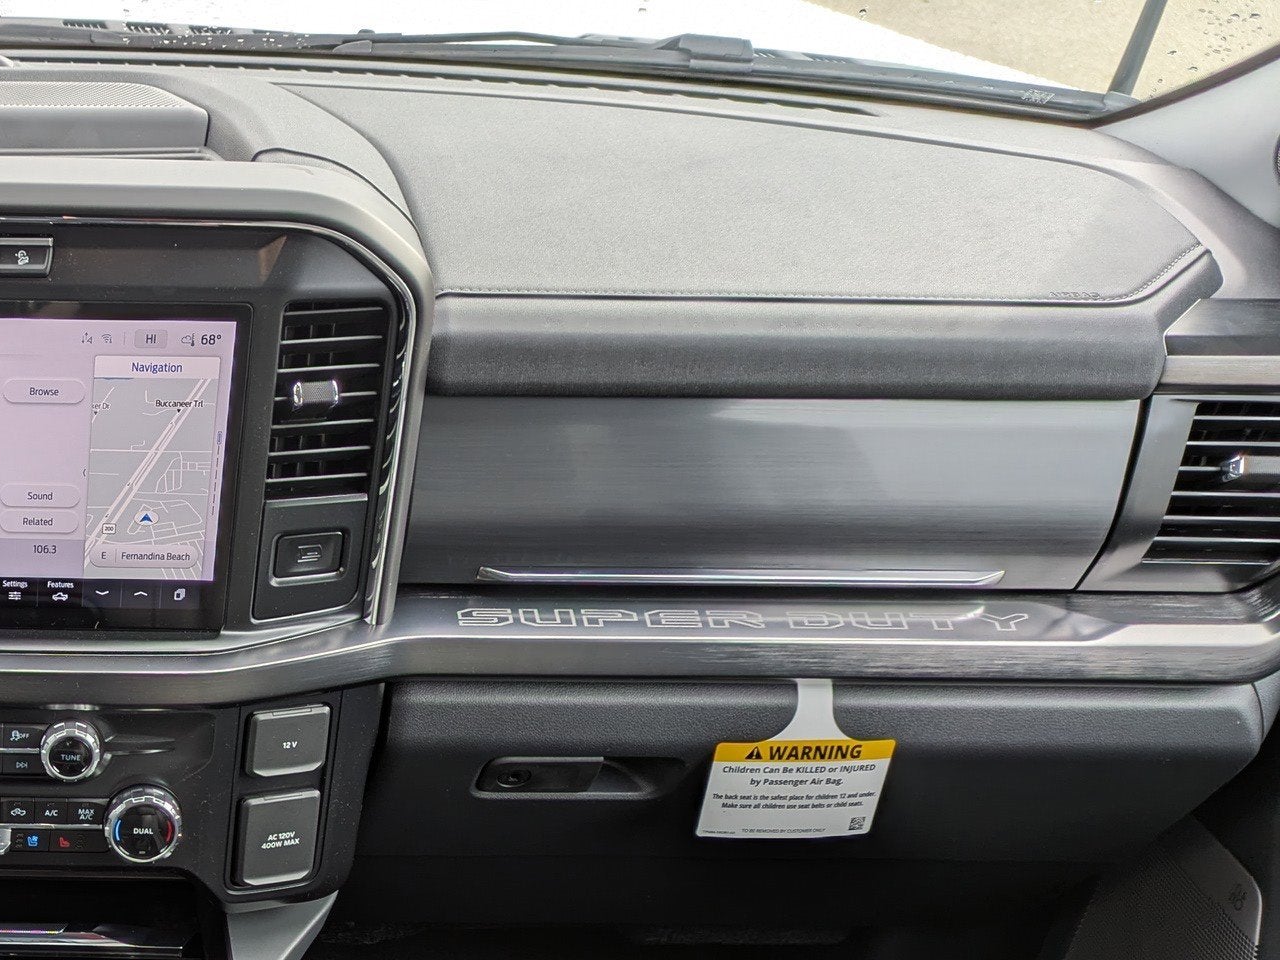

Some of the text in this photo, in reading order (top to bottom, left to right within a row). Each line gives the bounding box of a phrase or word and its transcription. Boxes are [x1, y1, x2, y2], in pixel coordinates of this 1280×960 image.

[146, 335, 156, 344] HI
[201, 334, 222, 346] 68°
[131, 363, 183, 373] Navigation
[29, 387, 59, 396] Browse
[155, 400, 191, 408] Buccaneer
[27, 492, 53, 500] Sound
[22, 517, 53, 526] Related
[33, 545, 57, 554] 106.3
[121, 552, 190, 561] Fernandina Beach
[2, 580, 28, 588] Settings
[457, 608, 1028, 631] SUPER DUTY
[769, 744, 862, 760] WARNING
[840, 764, 876, 773] INJURED
[750, 778, 760, 787] by
[763, 779, 808, 787] Passenger
[825, 778, 843, 786] Bag.
[268, 831, 295, 841] AC 120V
[261, 838, 300, 849] 400W MAX
